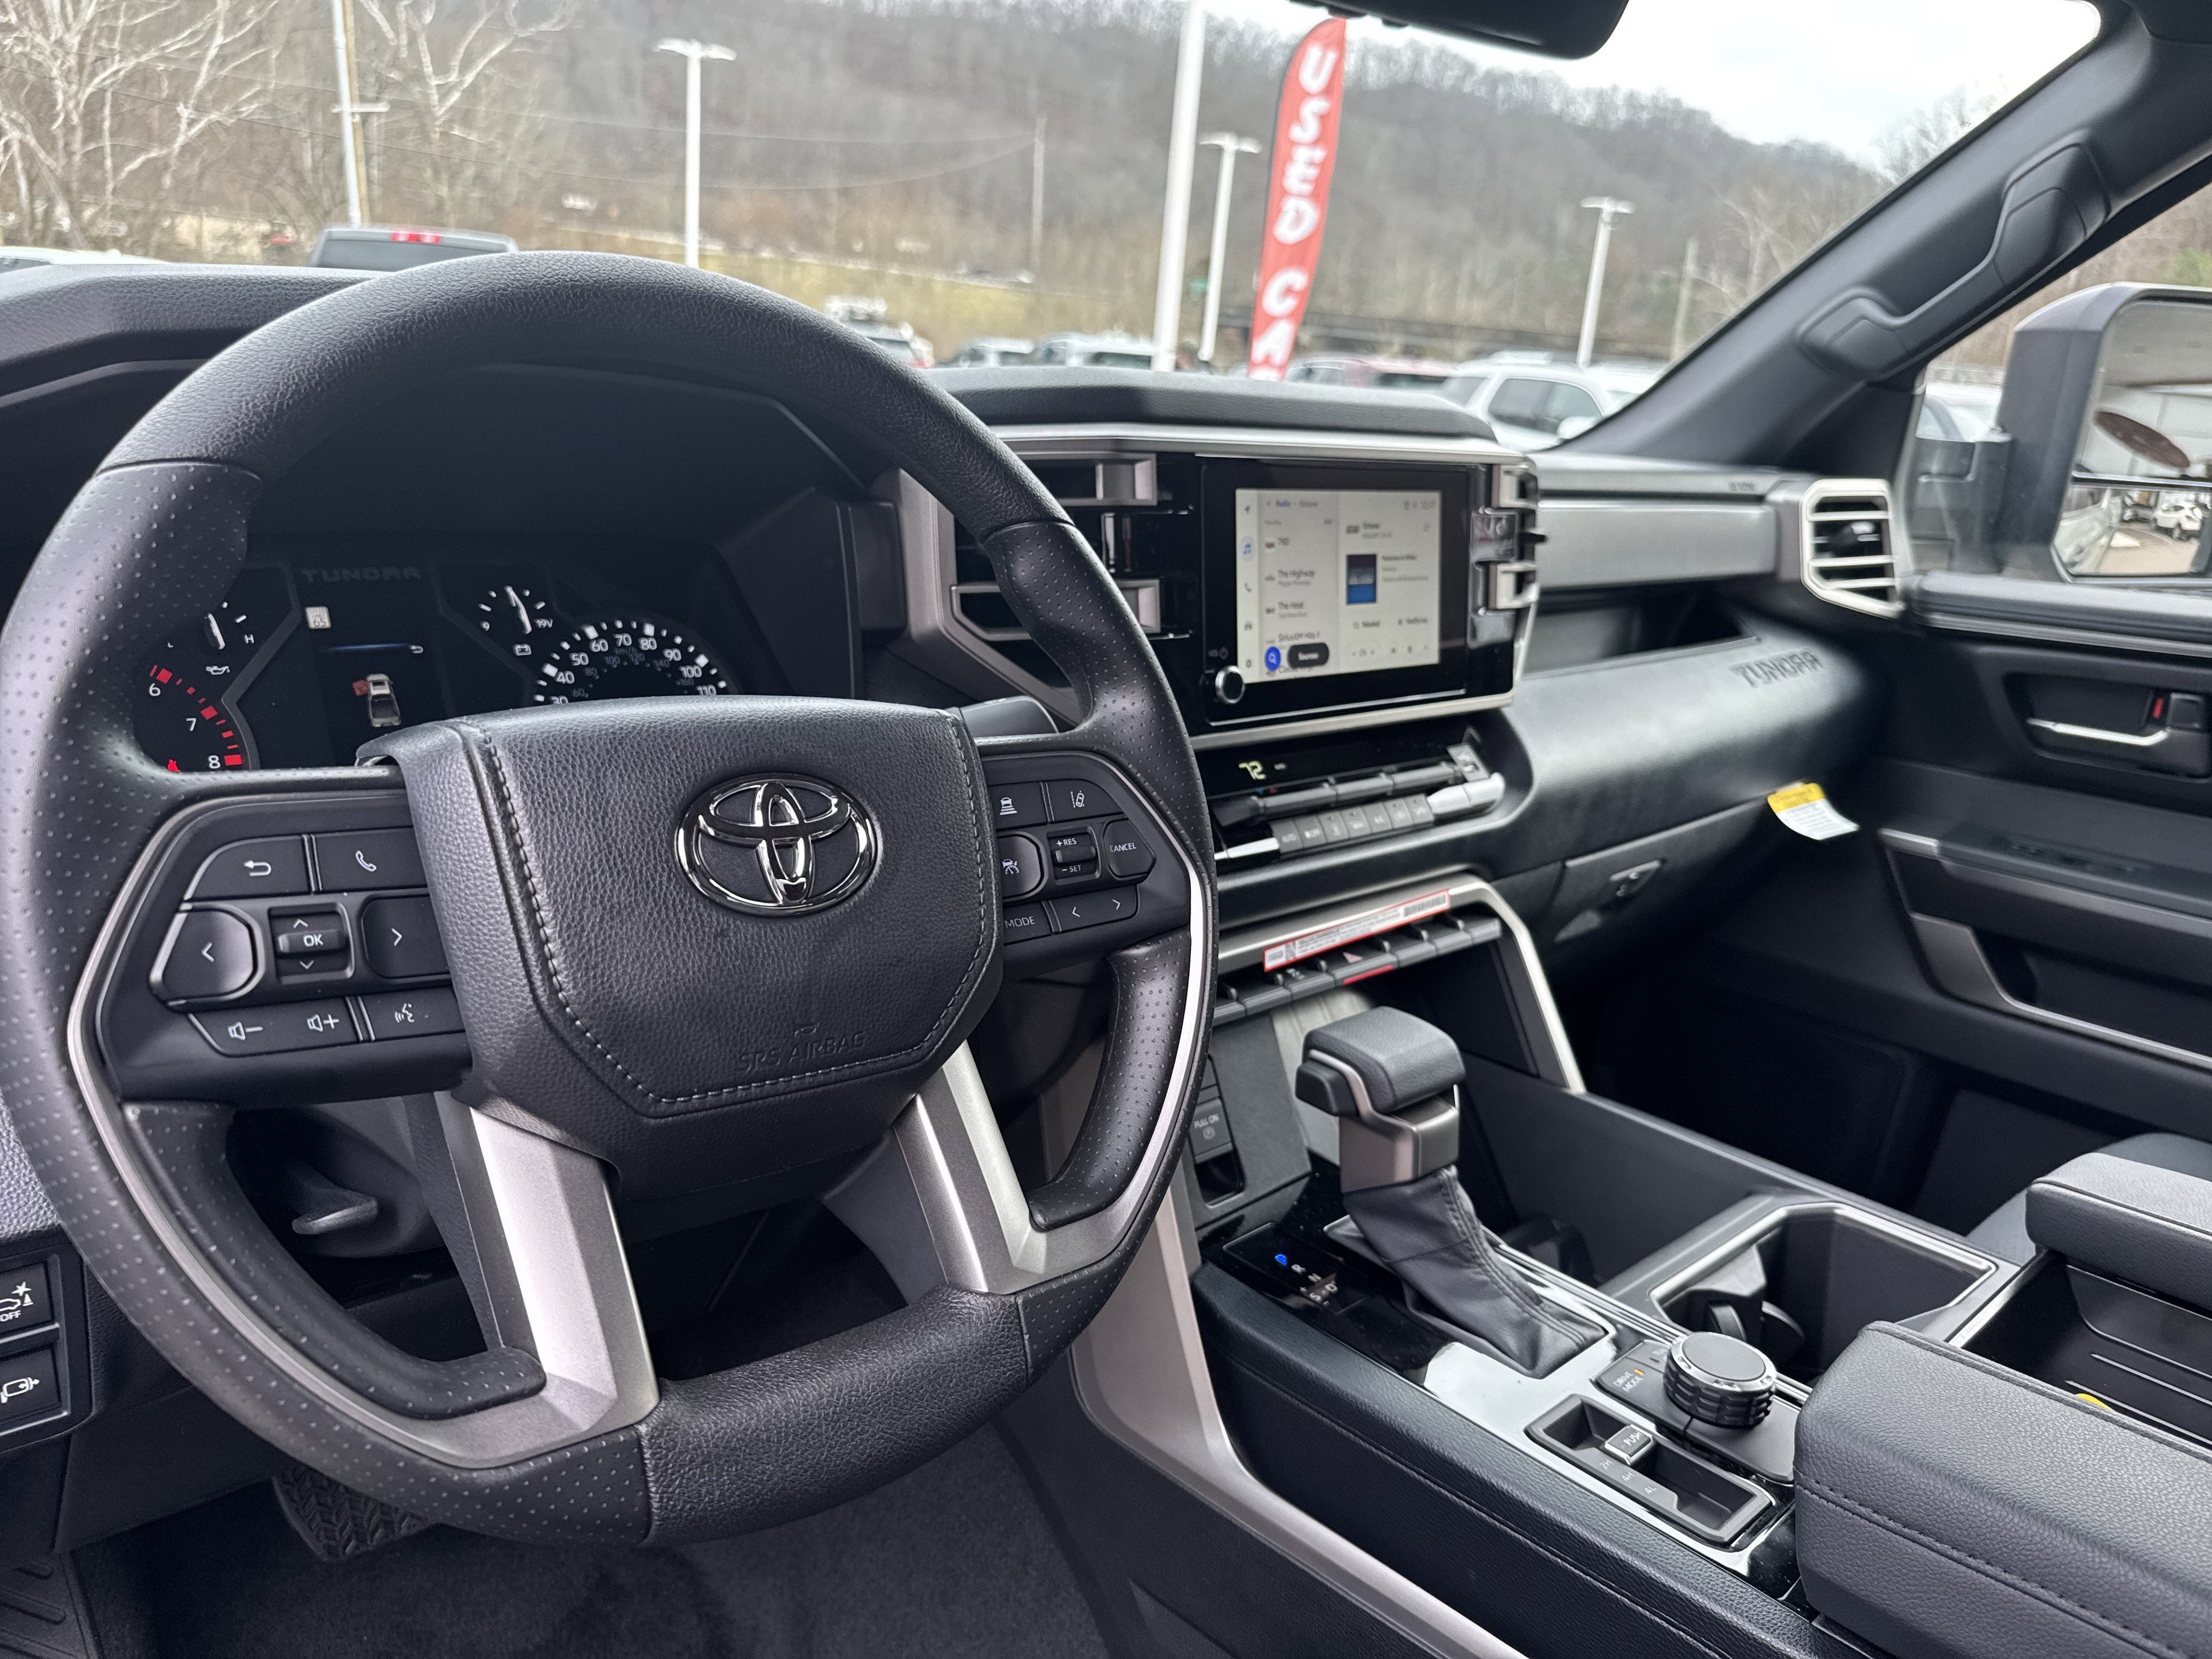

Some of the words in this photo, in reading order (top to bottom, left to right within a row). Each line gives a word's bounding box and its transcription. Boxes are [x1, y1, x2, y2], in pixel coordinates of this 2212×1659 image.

[1272, 43, 1339, 246] USED
[301, 567, 421, 583] TUNDRA
[313, 619, 326, 627] 65
[533, 618, 553, 629] 19V
[244, 634, 255, 644] H
[589, 639, 608, 652] 60
[613, 633, 632, 647] 70
[638, 637, 657, 651] 80
[569, 652, 589, 666] 50
[663, 648, 682, 662] 90
[679, 664, 702, 678] 100
[1728, 651, 1825, 688] TUNDRA
[555, 670, 575, 684] 40
[149, 684, 161, 697] 6
[695, 684, 716, 696] 110
[186, 718, 196, 732] 7
[208, 755, 221, 769] 8
[1238, 760, 1266, 780] 72
[1109, 842, 1137, 853] CANCEL
[1005, 916, 1036, 928] MODE
[303, 934, 324, 947] OK
[789, 1031, 868, 1064] AIRBAG
[1291, 1263, 1306, 1275] R
[0, 1310, 21, 1322] OFF
[1613, 1371, 1634, 1387] DRIVE
[1623, 1430, 1644, 1446] PUSH
[1599, 1458, 1613, 1470] 2H
[1621, 1471, 1635, 1482] 4H
[1644, 1486, 1657, 1494] 4L
